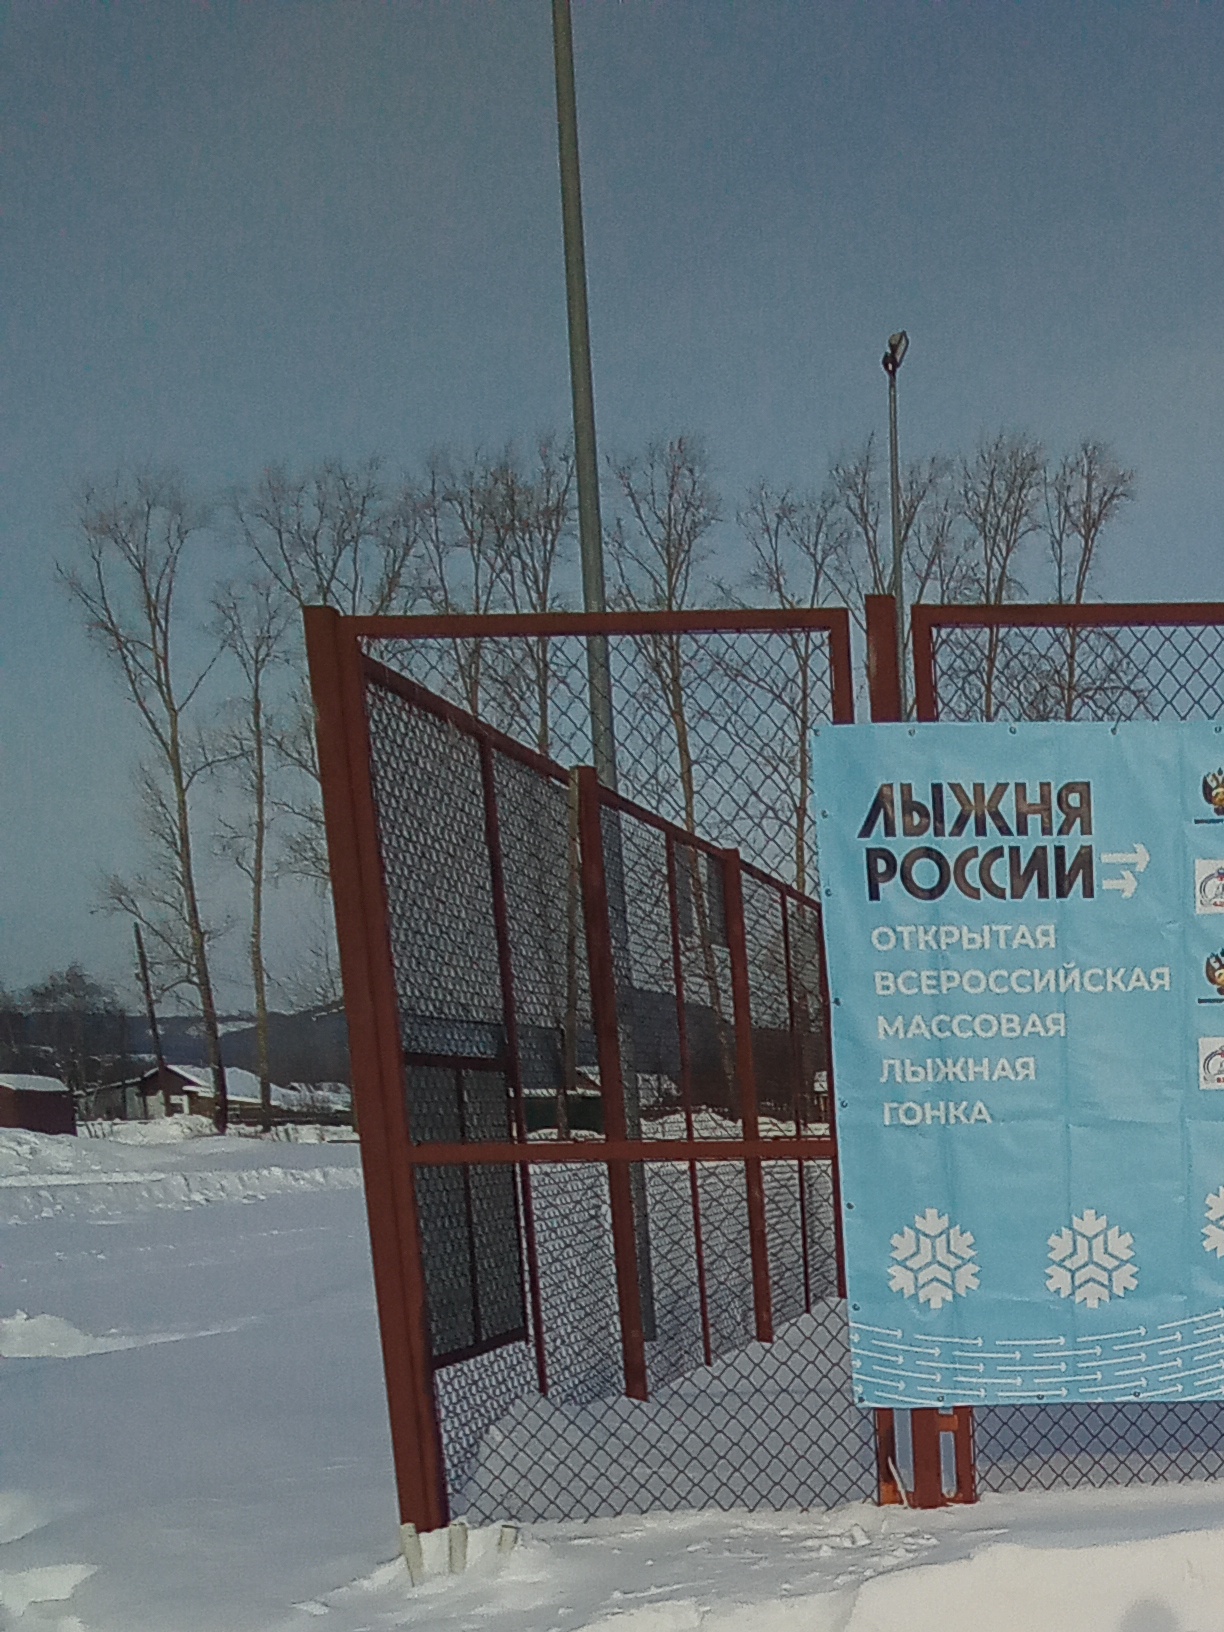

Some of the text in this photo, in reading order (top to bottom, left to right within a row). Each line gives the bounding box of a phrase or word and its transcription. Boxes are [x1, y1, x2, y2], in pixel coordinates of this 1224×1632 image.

[857, 781, 1093, 838] ЛЫЖНЯ
[865, 844, 1094, 901] РОССИИ
[871, 924, 1057, 951] ОТКРЫТАЯ
[874, 962, 1171, 996] ВСЕРОССИЙСКАЯ
[877, 1012, 1067, 1040] МАССОВАЯ
[880, 1056, 1036, 1083] ЛЫЖНАЯ
[883, 1101, 993, 1126] ГОНКА
